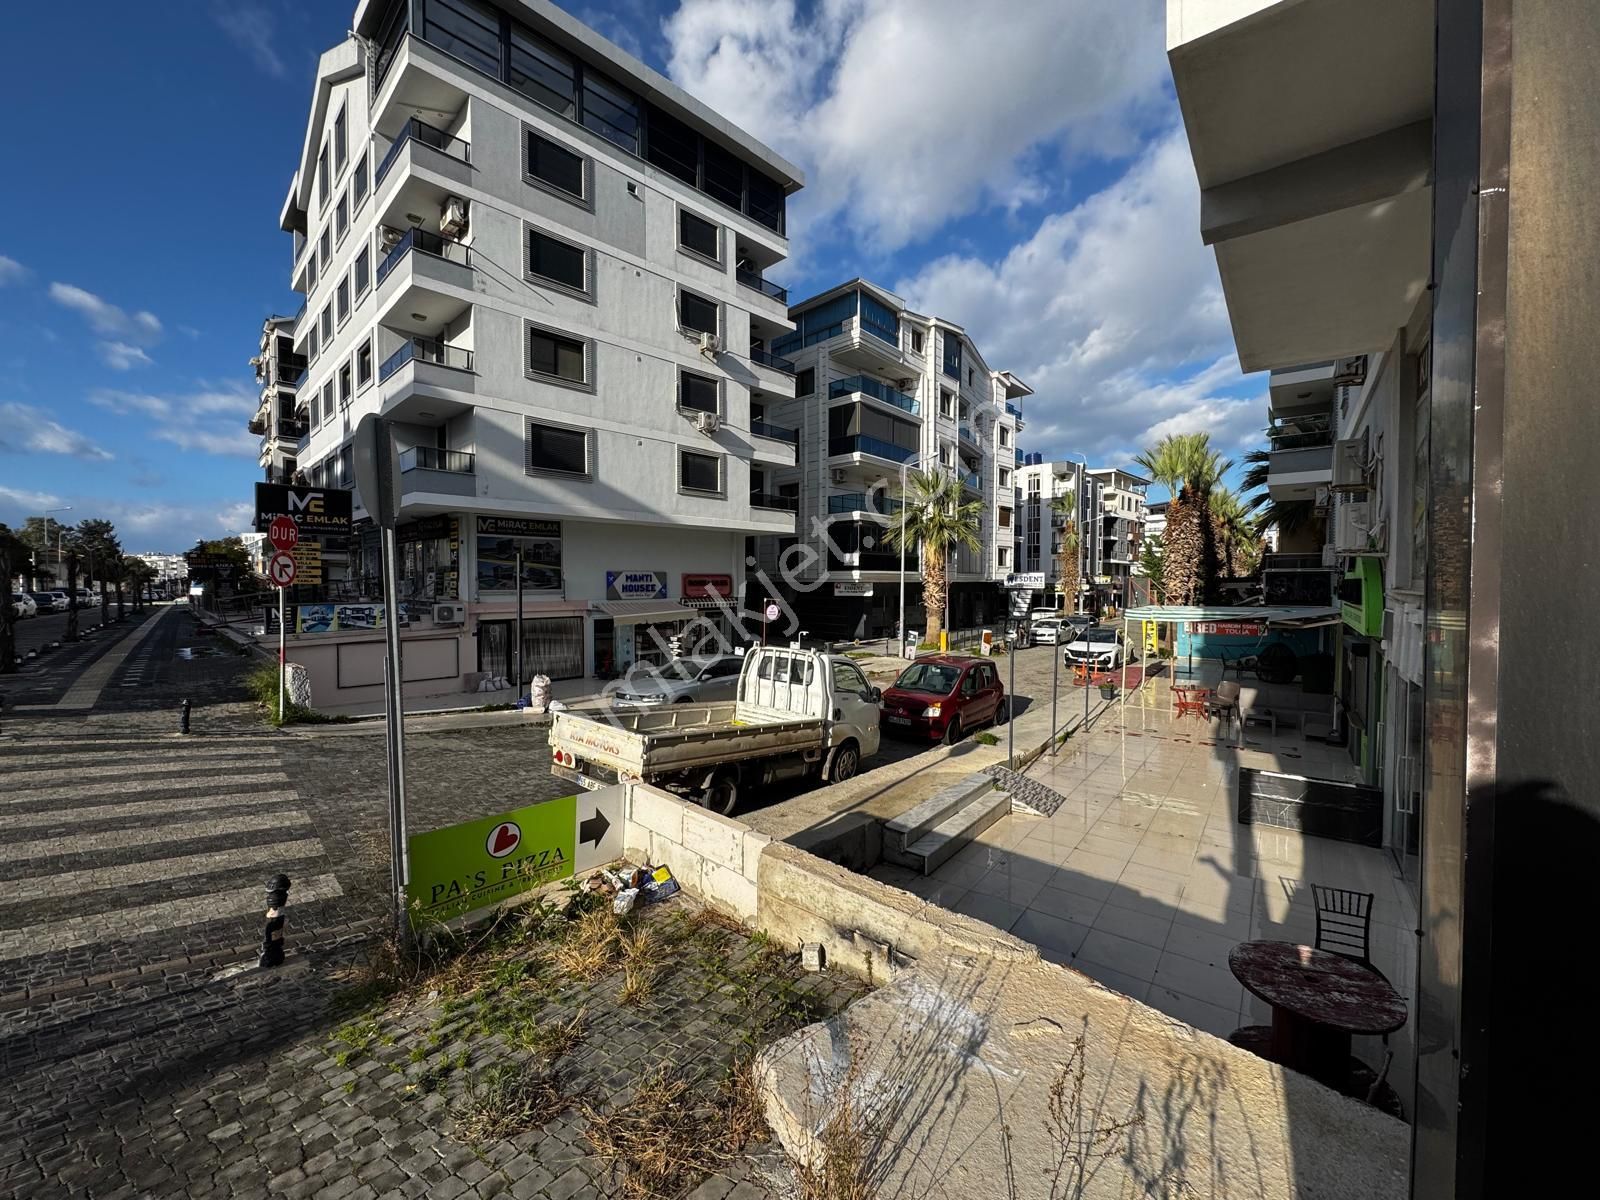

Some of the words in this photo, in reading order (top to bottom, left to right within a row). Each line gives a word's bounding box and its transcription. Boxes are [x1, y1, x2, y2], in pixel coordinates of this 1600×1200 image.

[306, 515, 349, 524] EMLAK
[272, 525, 297, 541] DUR
[621, 584, 656, 593] HOUSEE
[502, 848, 565, 880] PIZZA
